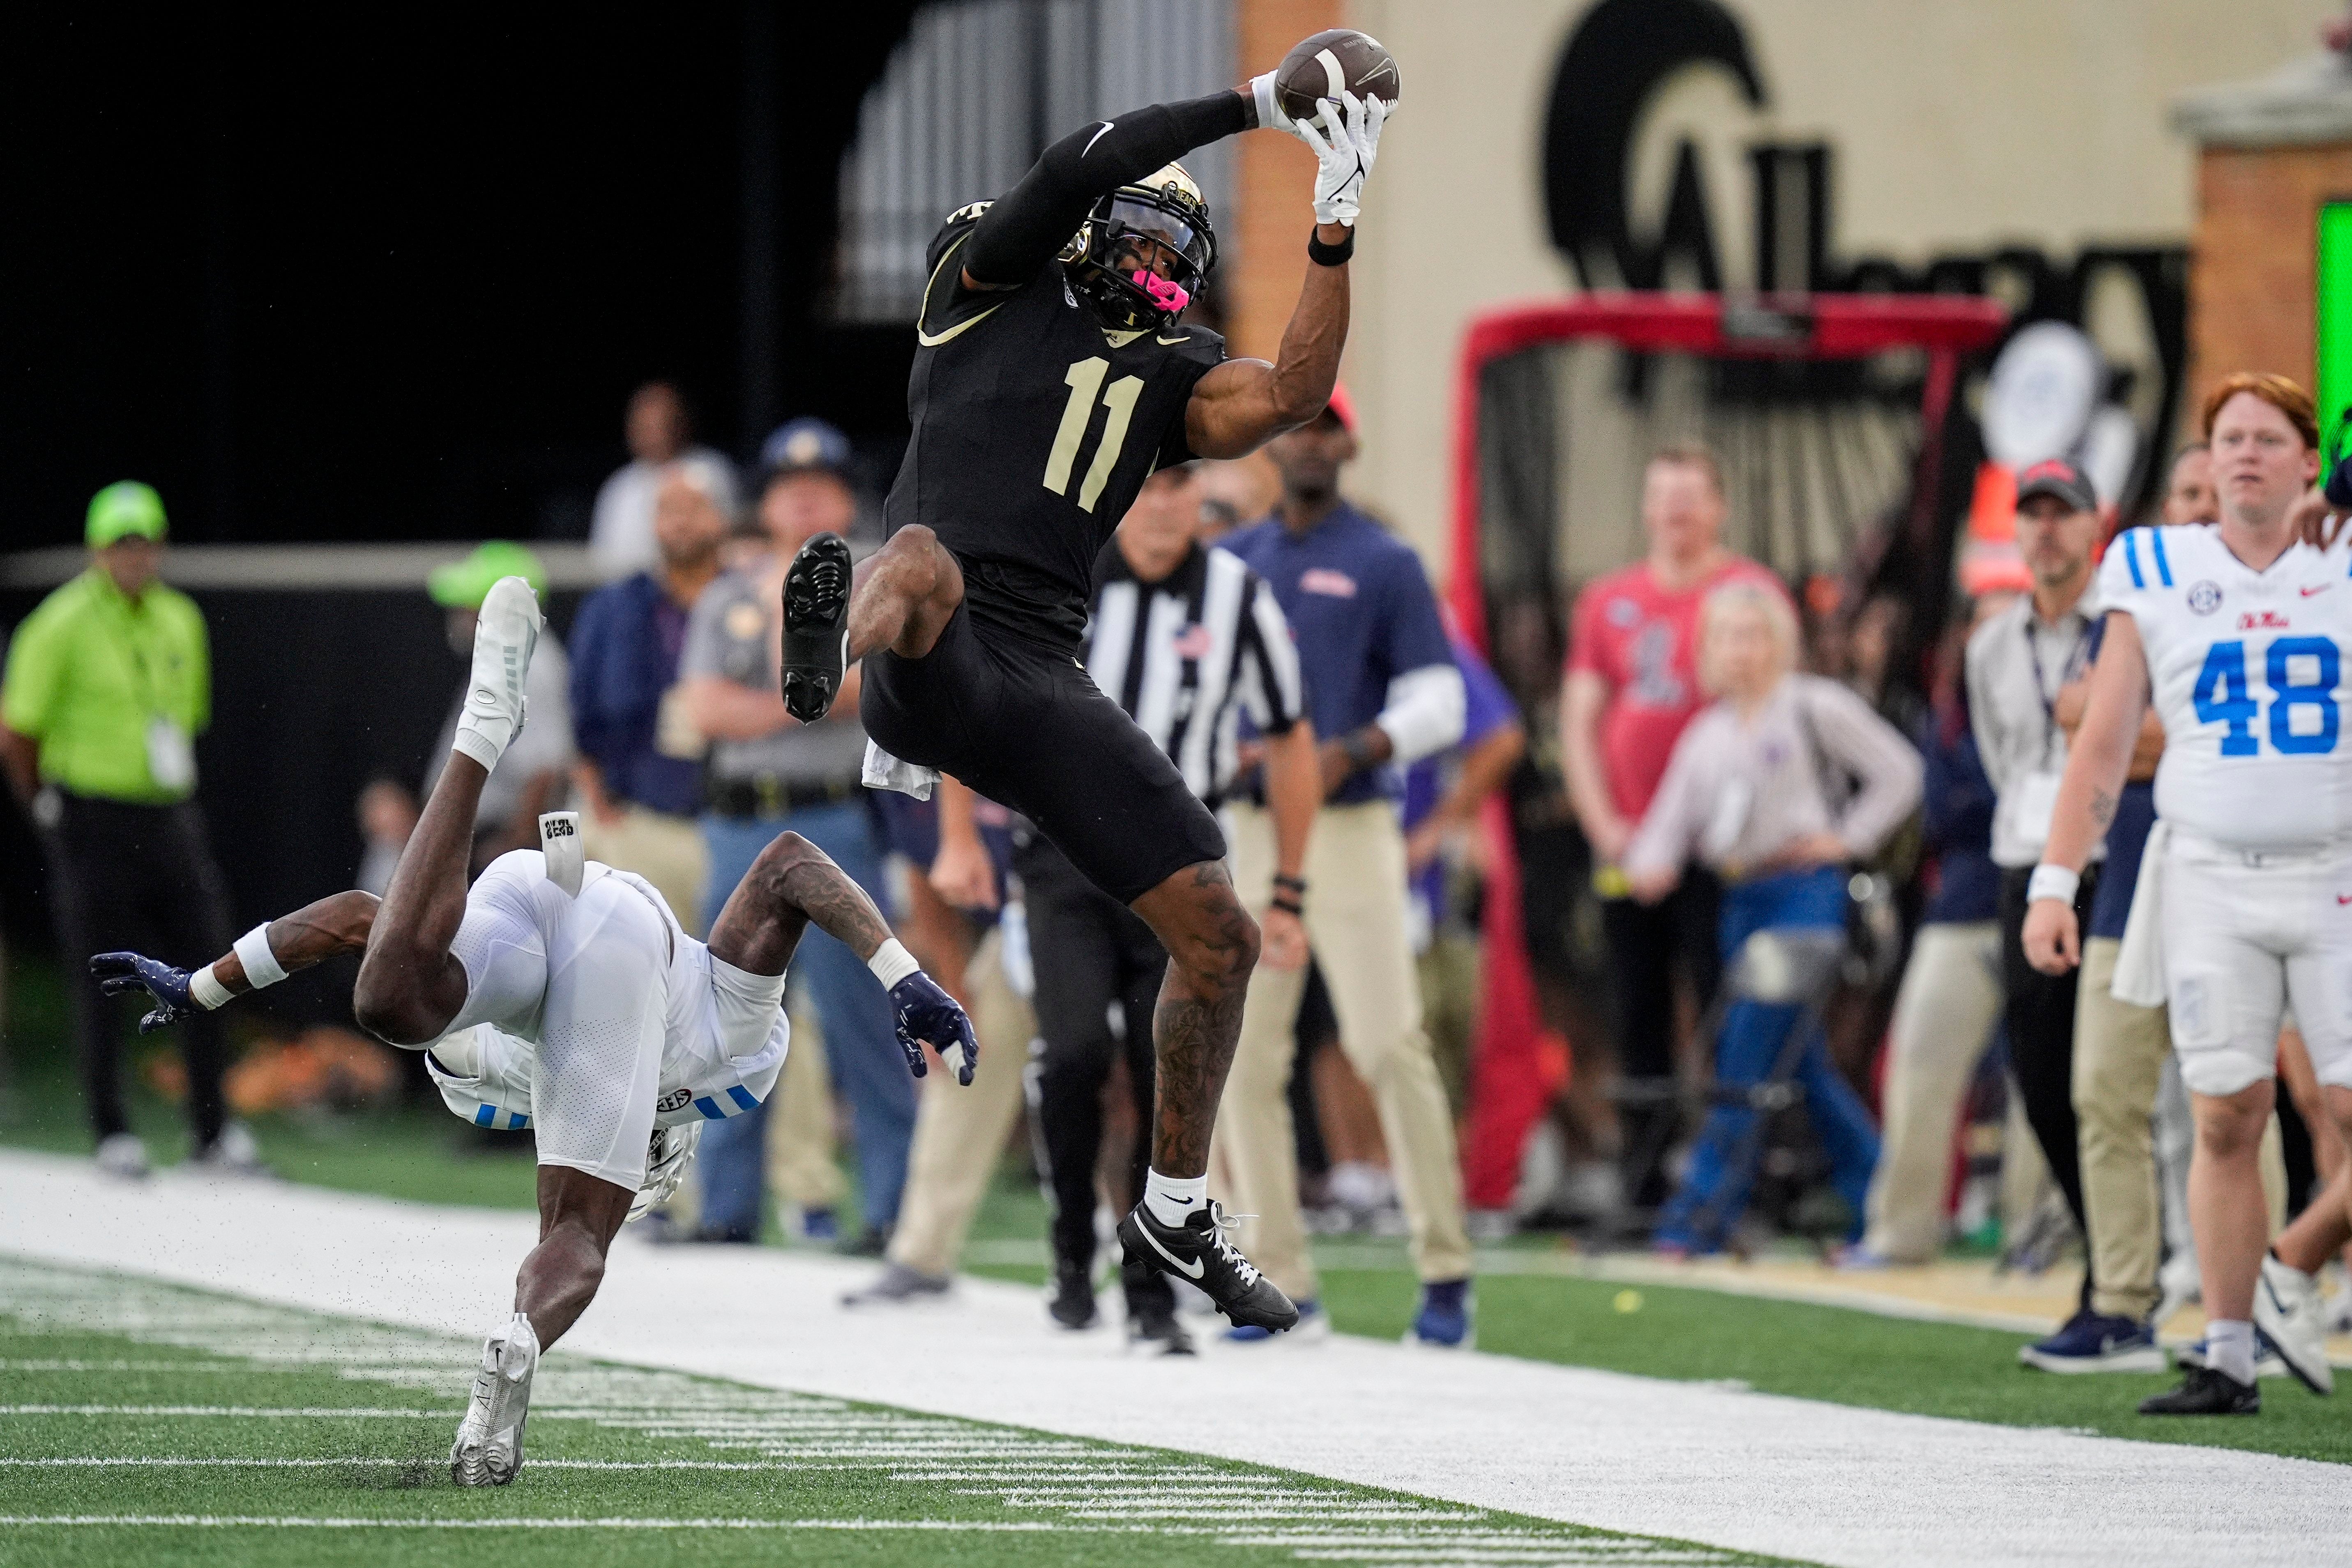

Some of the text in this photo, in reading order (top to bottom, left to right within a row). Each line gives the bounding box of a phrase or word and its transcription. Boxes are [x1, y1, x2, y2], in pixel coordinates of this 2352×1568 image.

[1043, 356, 1145, 513] 11
[2192, 635, 2339, 756] 48
[658, 1090, 689, 1111] SEC
